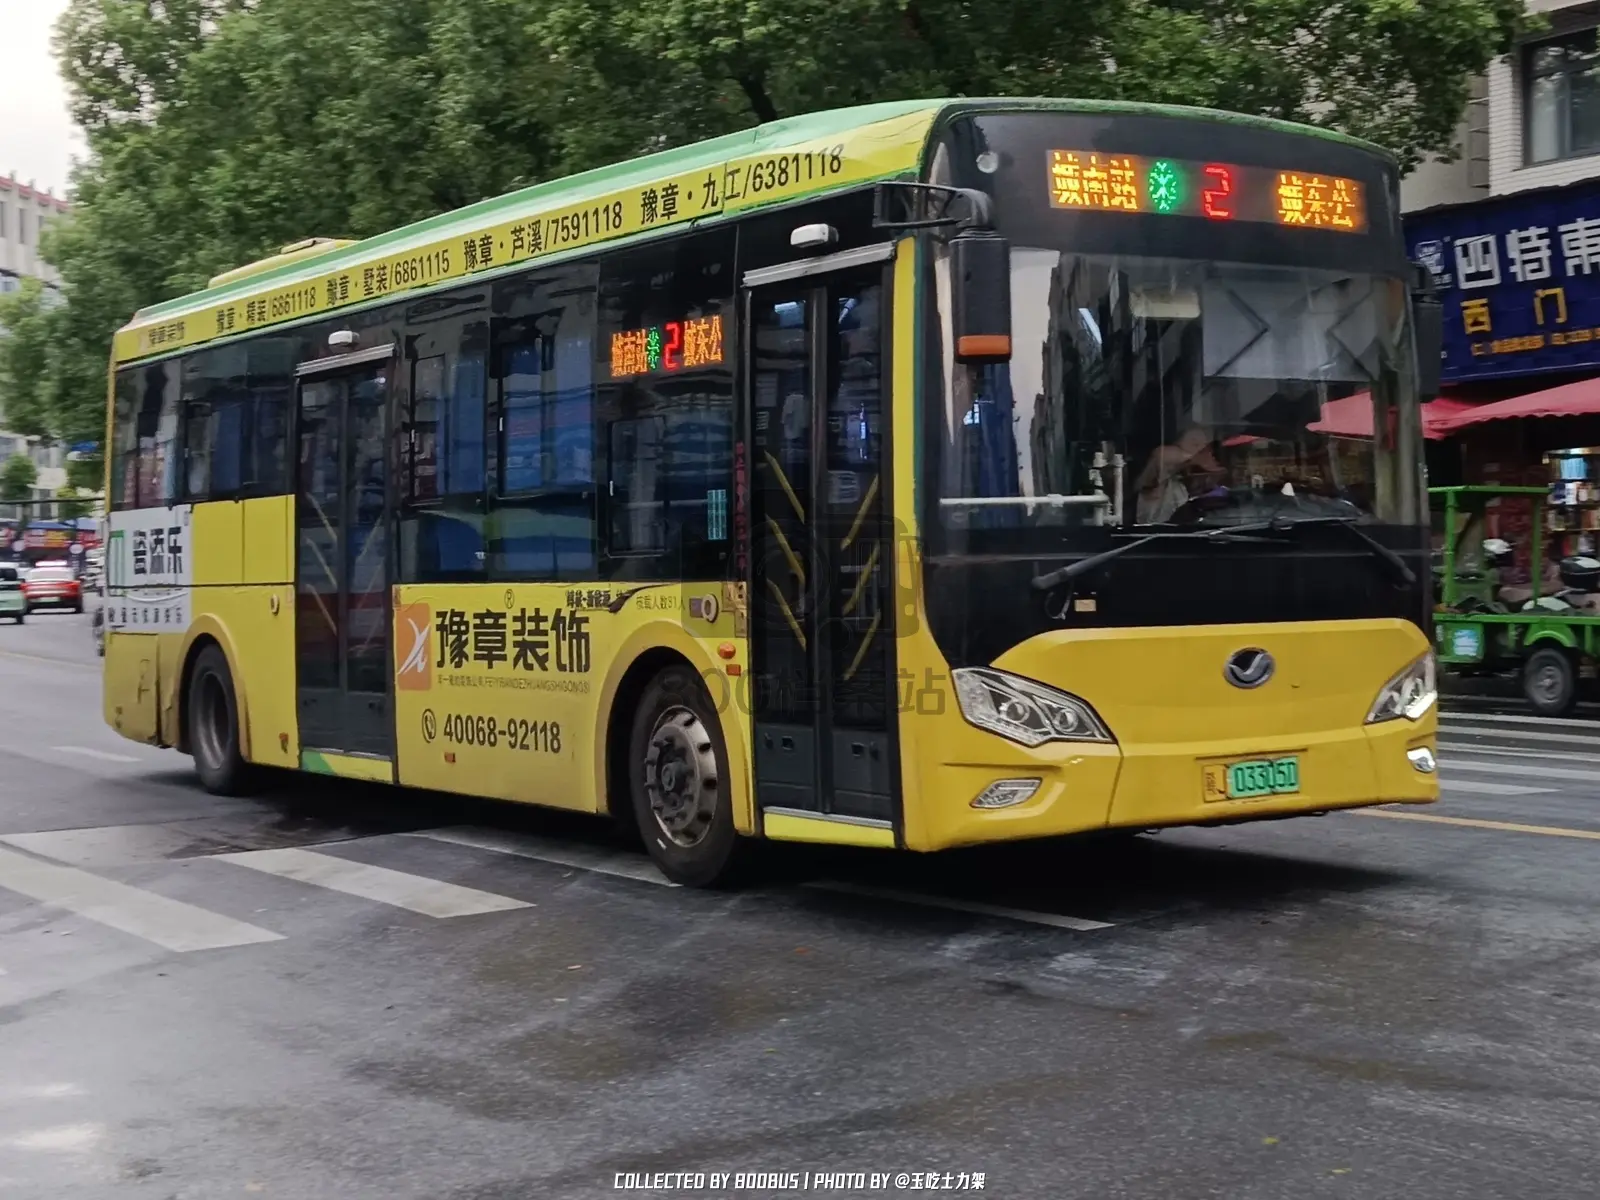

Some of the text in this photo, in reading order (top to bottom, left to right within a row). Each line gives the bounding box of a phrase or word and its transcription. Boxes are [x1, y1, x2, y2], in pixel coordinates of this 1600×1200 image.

[1203, 166, 1230, 218] 2
[664, 321, 681, 372] 2
[435, 607, 592, 673] 豫章装饰
[443, 713, 562, 754] 40068-92118
